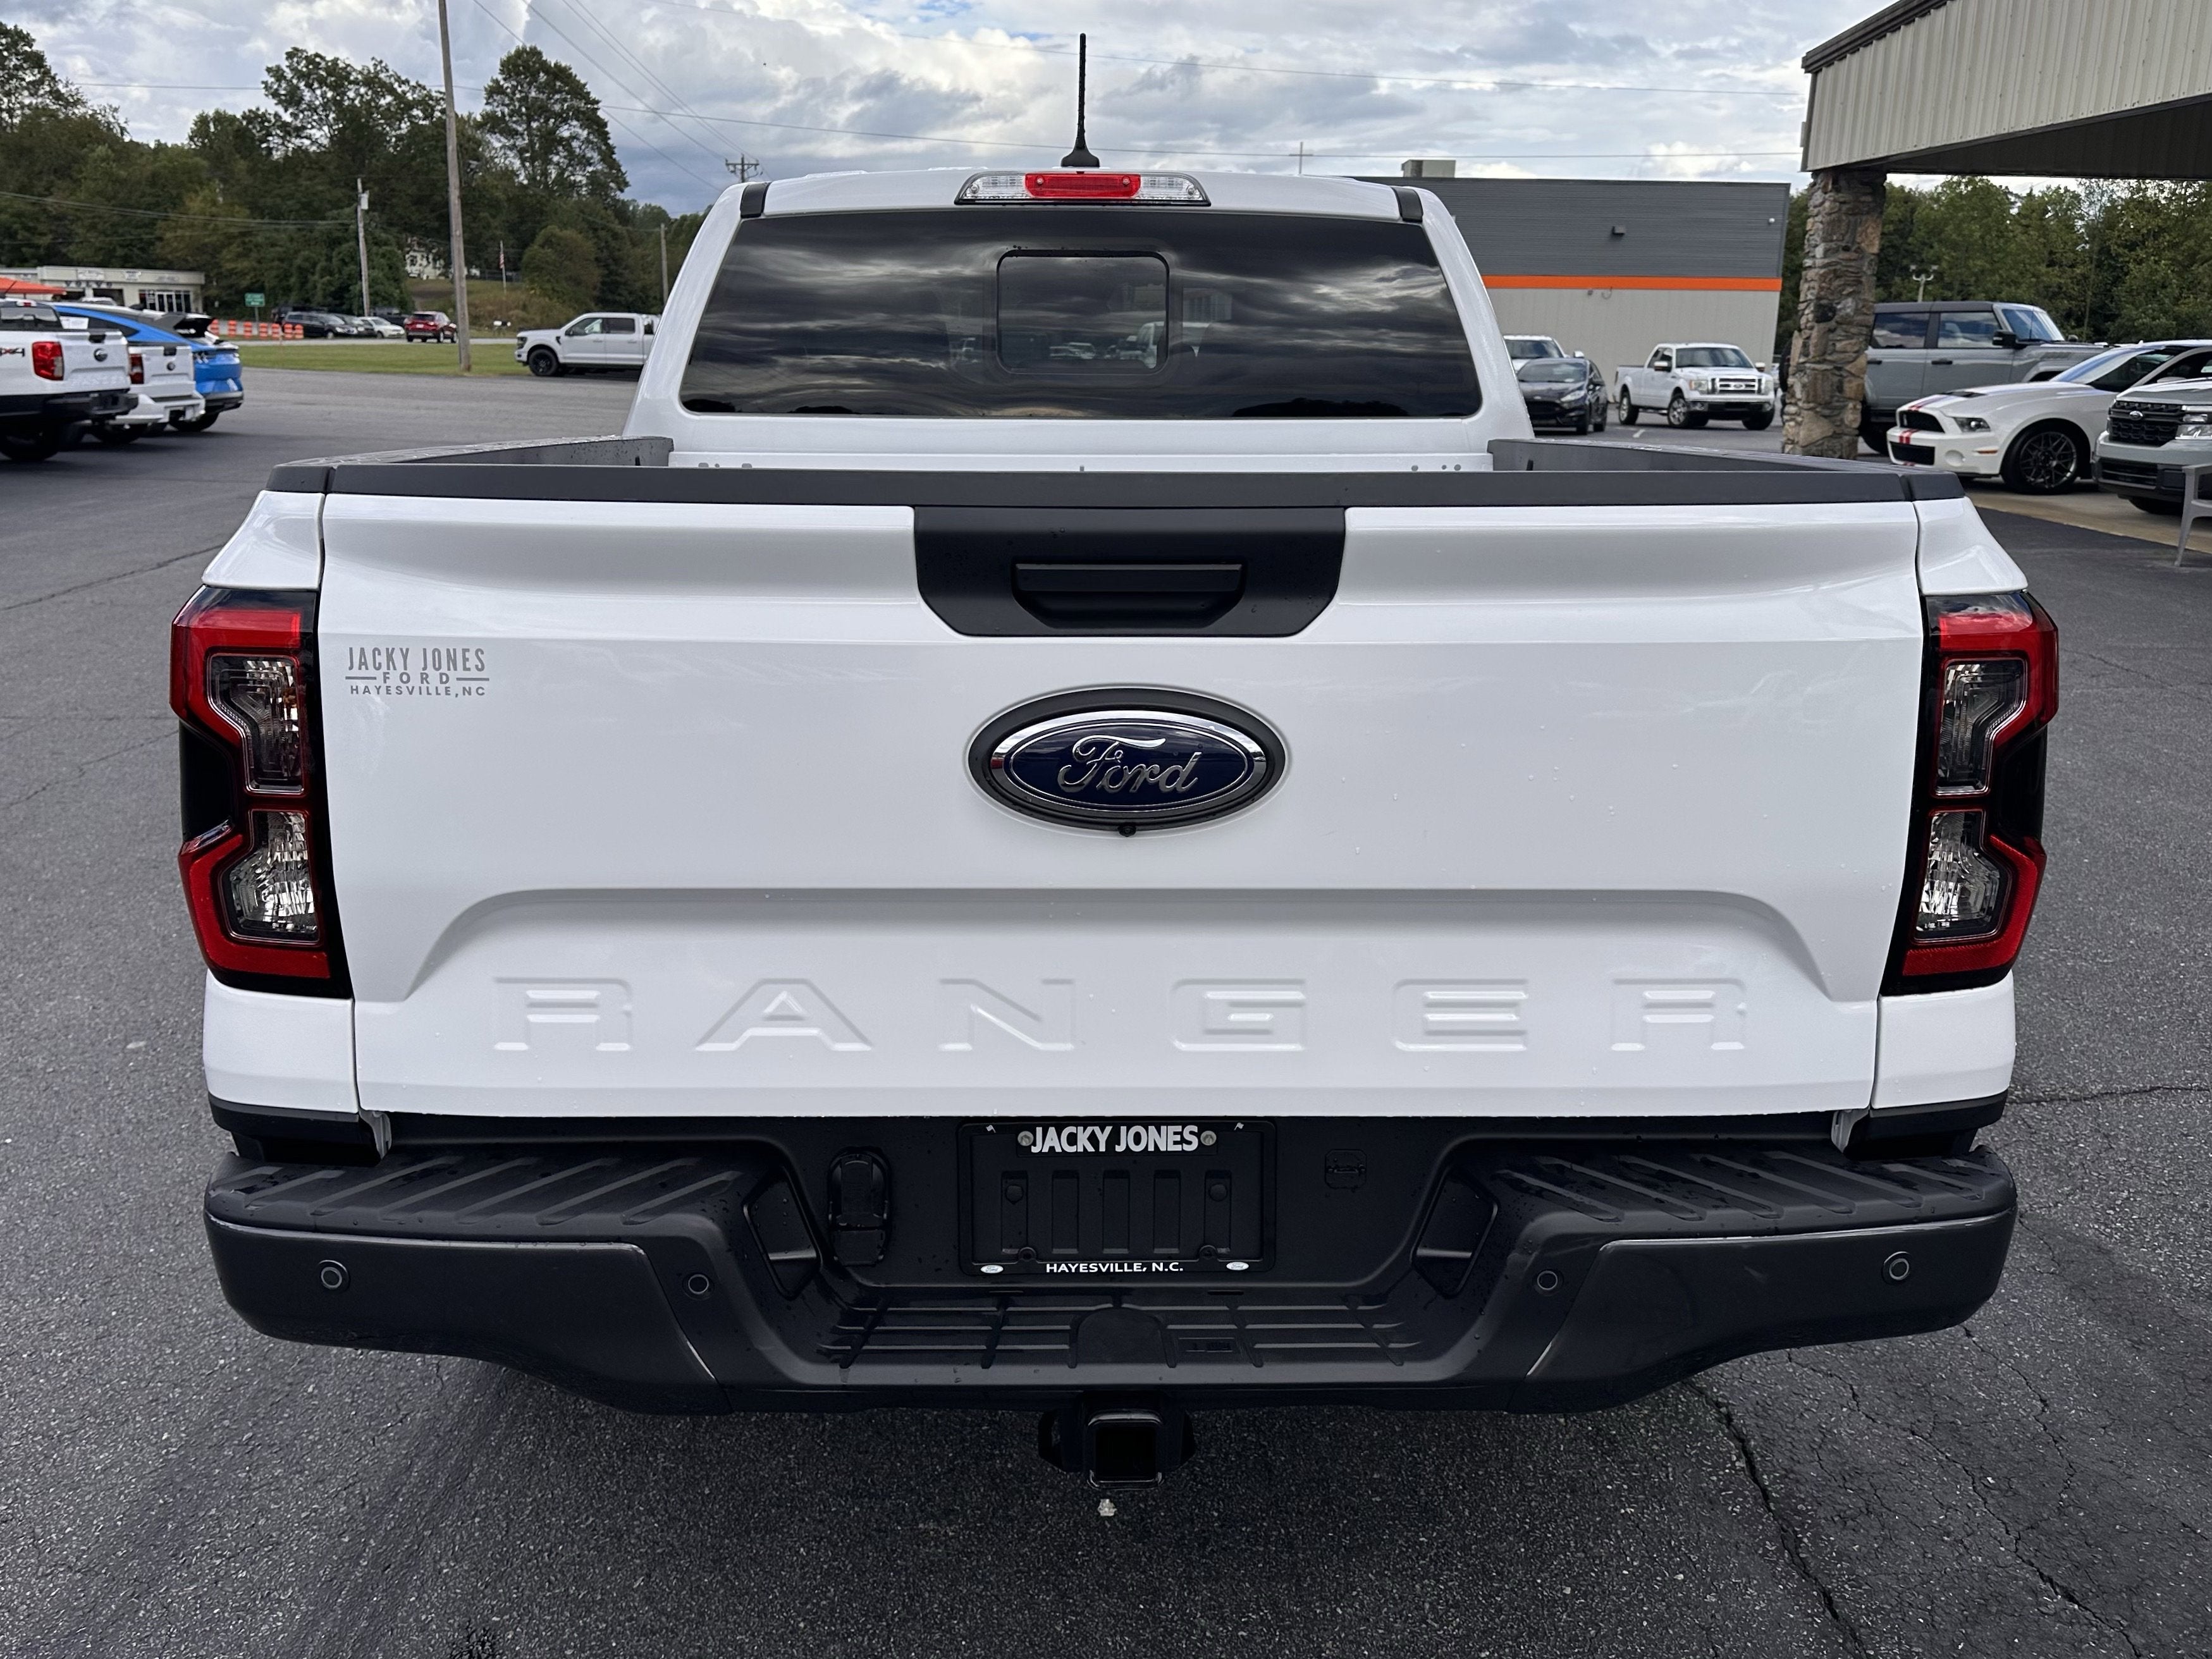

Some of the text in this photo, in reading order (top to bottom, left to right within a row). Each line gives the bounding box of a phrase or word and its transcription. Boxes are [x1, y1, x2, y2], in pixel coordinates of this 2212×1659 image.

[348, 647, 486, 671] JACKY JONES
[383, 672, 450, 685] FORD
[1057, 735, 1201, 793] Ford
[493, 977, 1748, 1054] RANGER
[1031, 1125, 1198, 1153] JACKY JONES
[1046, 1261, 1184, 1273] HAYESVILLE, N.C.
